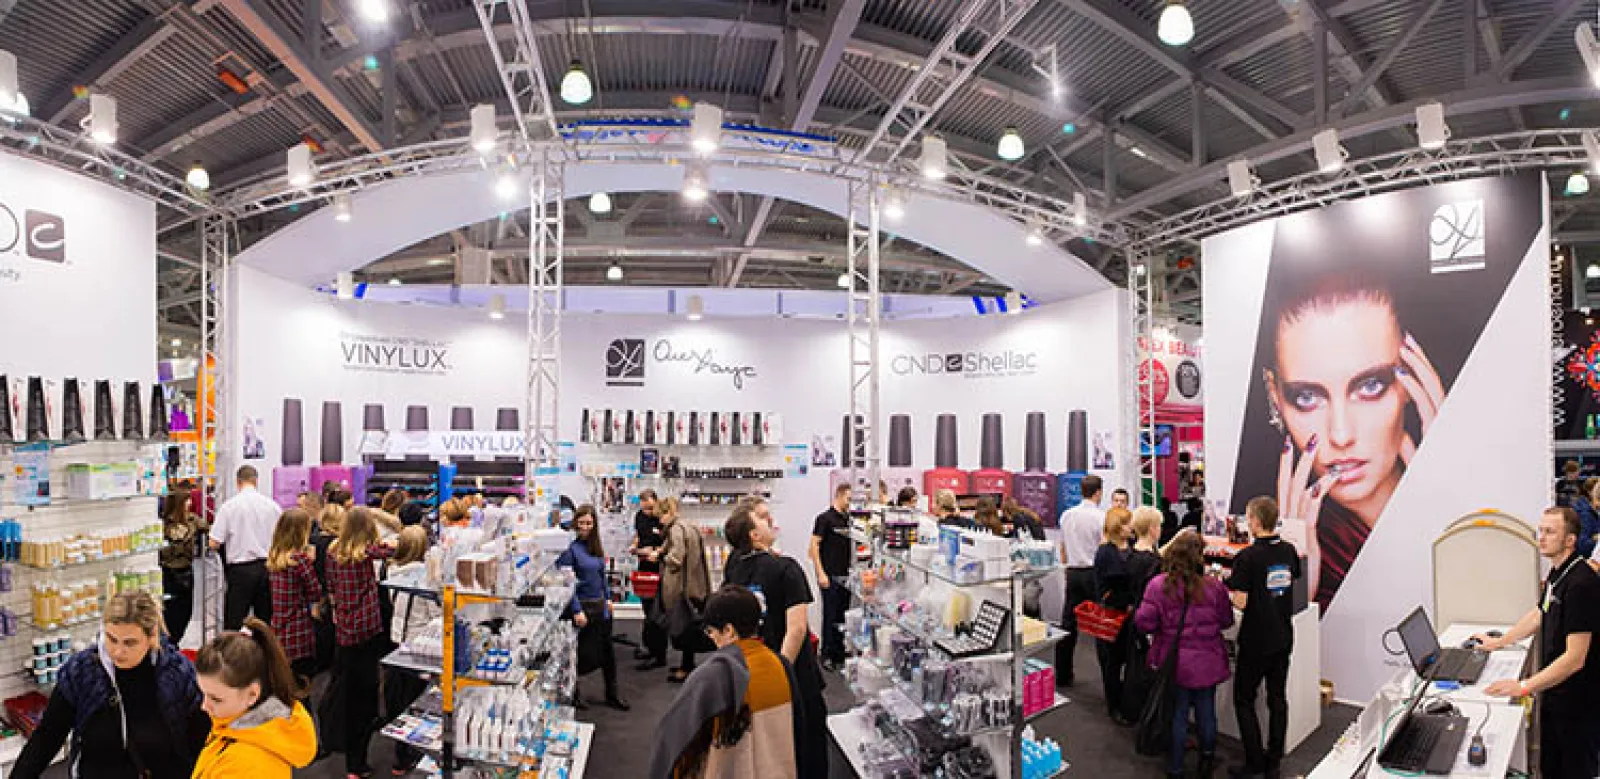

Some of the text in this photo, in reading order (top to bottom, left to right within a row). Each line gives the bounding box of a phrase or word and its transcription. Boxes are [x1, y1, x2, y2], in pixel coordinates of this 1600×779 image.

[341, 341, 446, 369] VINYLUX
[892, 350, 1037, 374] CND Shellac
[442, 434, 524, 451] VINYLUX
